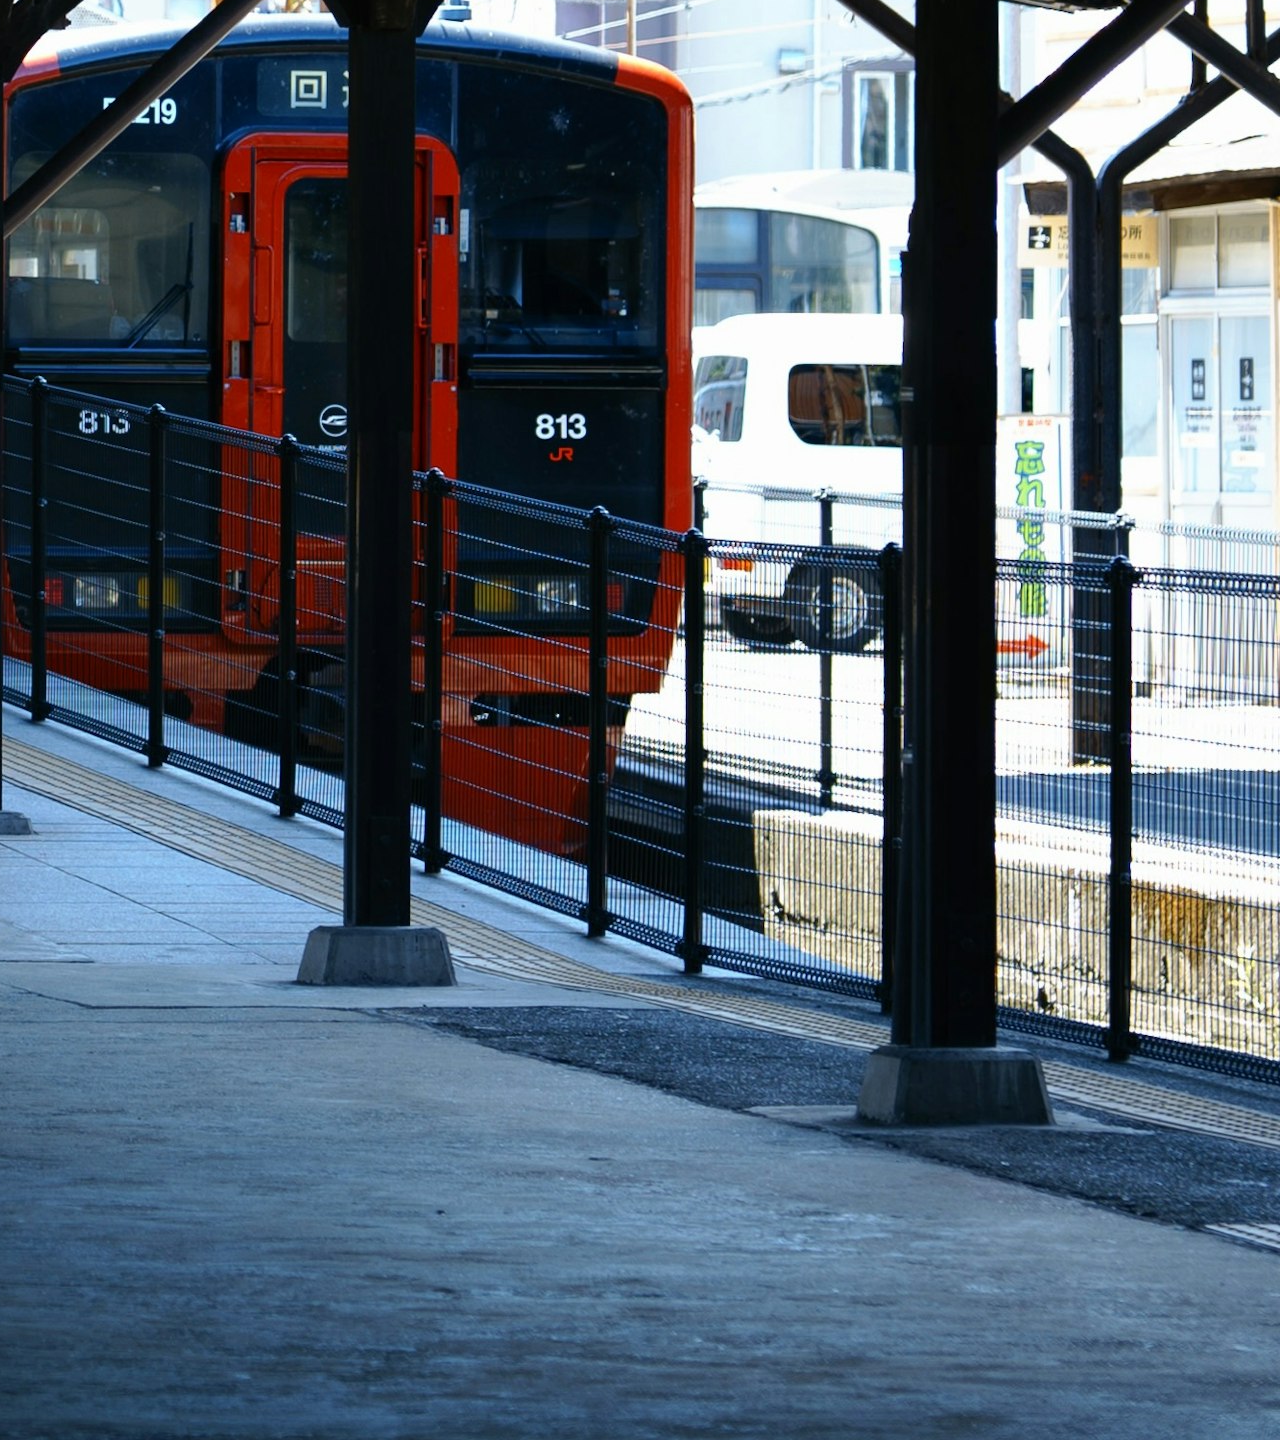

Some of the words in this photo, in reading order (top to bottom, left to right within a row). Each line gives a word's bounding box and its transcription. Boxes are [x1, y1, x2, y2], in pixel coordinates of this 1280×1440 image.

[289, 69, 349, 110] 回
[78, 408, 131, 435] 813
[534, 412, 587, 440] 813
[548, 446, 574, 462] JR
